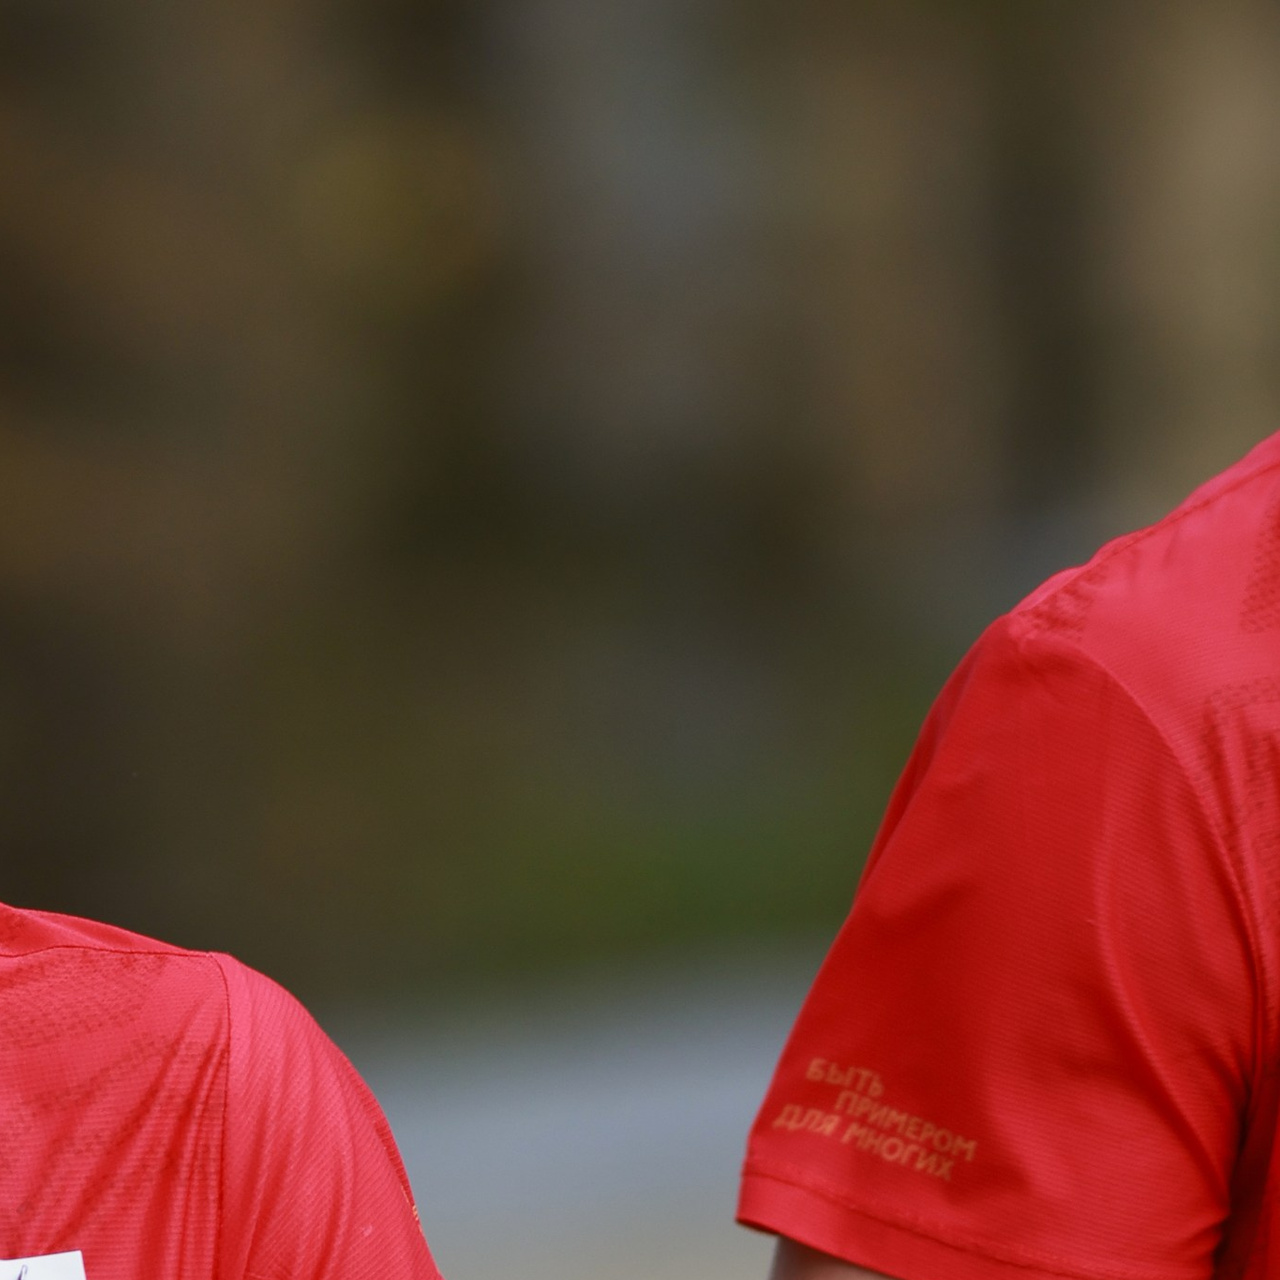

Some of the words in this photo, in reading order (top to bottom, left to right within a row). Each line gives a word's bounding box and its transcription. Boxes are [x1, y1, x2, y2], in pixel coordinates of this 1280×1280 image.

[806, 1057, 884, 1096] БЫТЬ
[773, 1103, 840, 1136] ДЛЯ
[841, 1122, 954, 1181] МНОГИХ
[835, 1090, 978, 1161] ПРИМЕРОМ
